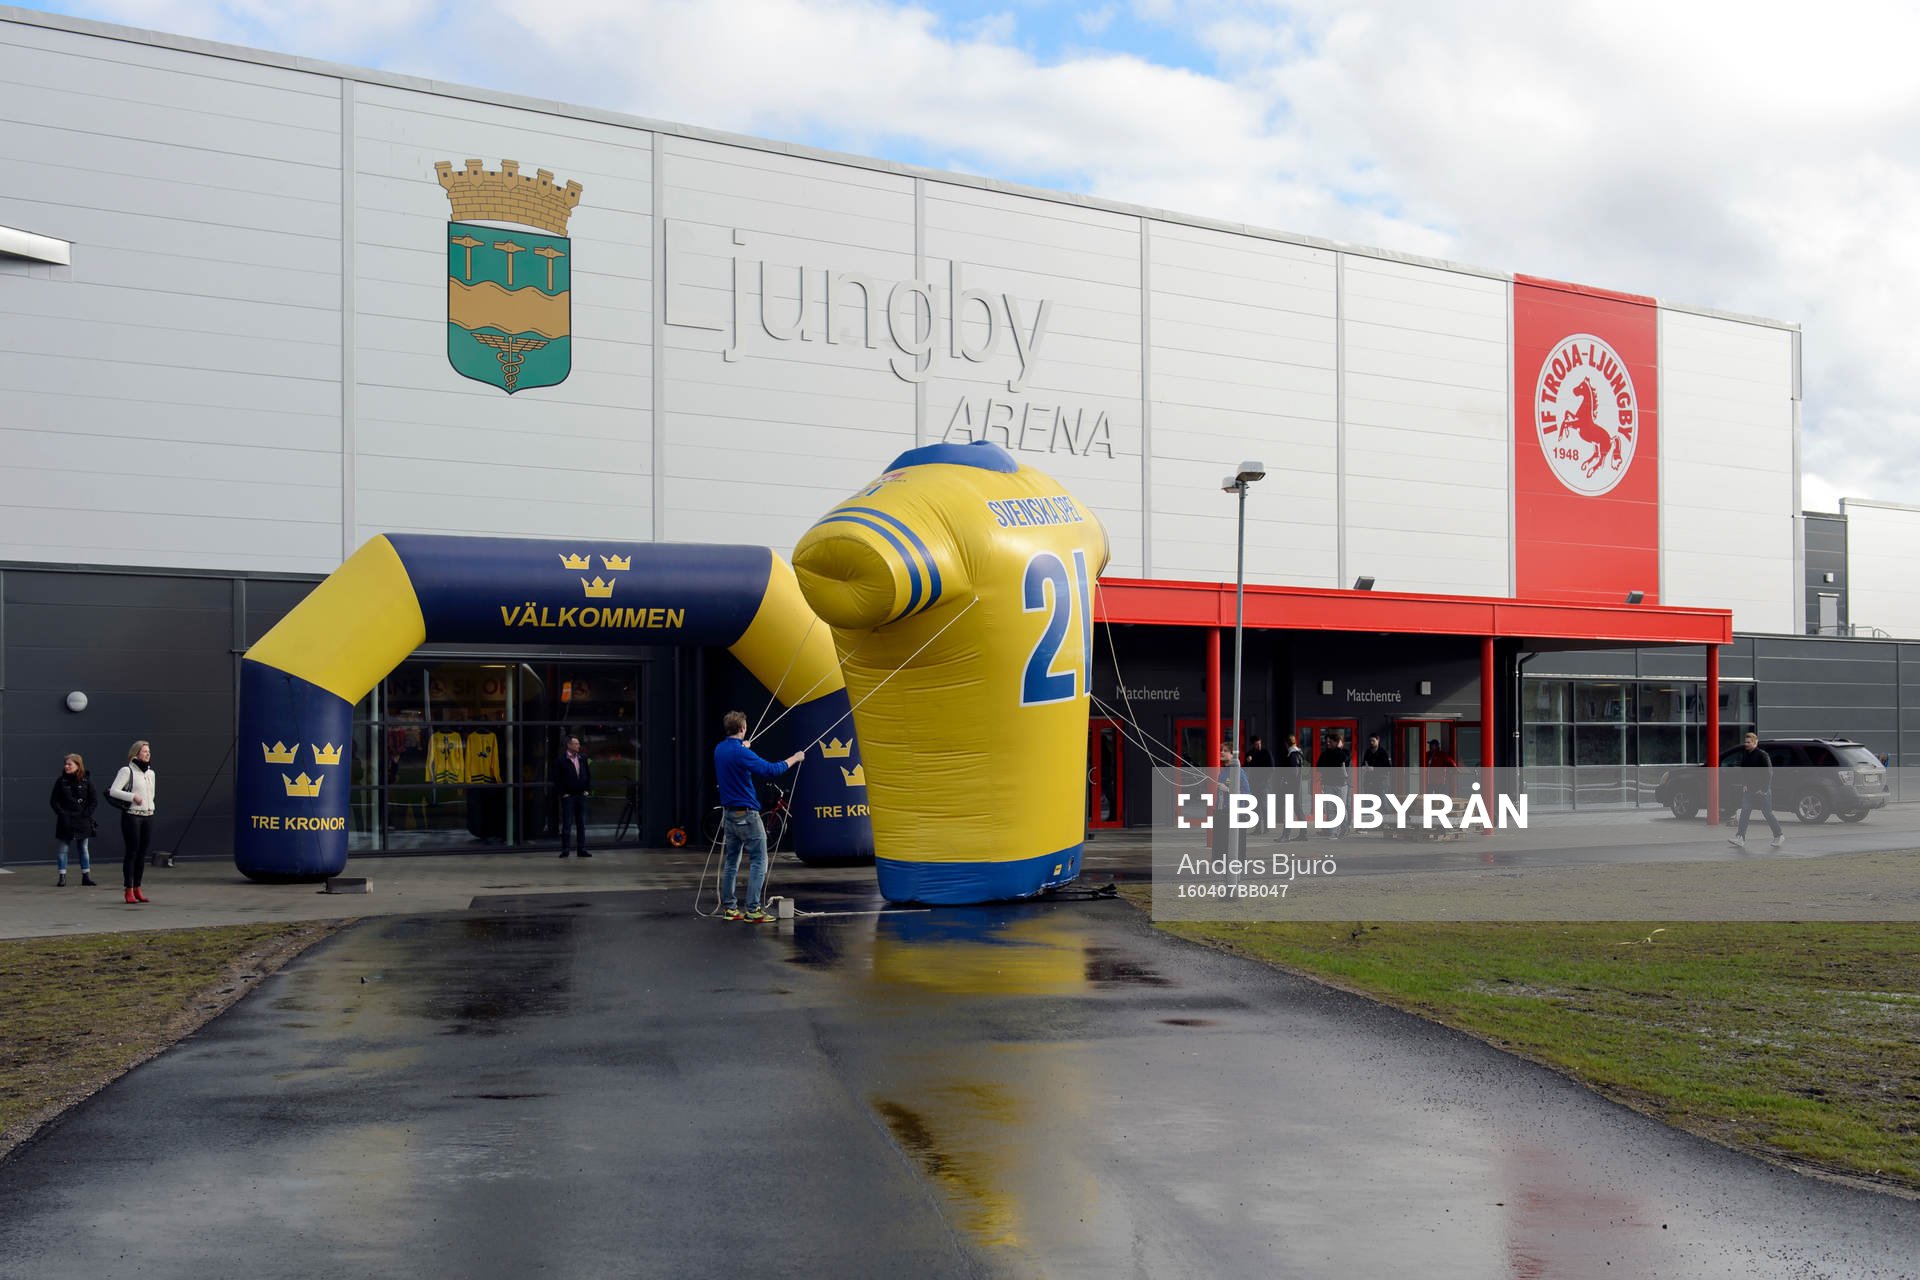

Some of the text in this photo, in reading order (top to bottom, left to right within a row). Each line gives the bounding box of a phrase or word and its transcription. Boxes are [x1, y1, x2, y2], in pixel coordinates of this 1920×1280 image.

[664, 217, 1051, 393] Ljungby
[1541, 343, 1633, 442] IF TROJA-LJUNGBY
[942, 396, 1117, 459] ARENA
[1553, 447, 1579, 461] 1948
[986, 495, 1084, 529] SVENSKA SPEL
[500, 602, 685, 629] VÄLKOMMEN
[1019, 547, 1092, 708] 21
[1116, 685, 1180, 700] Matchentré
[1346, 688, 1401, 702] Matchentré
[251, 815, 345, 831] TRE KRONOR
[814, 804, 870, 818] TRE KR
